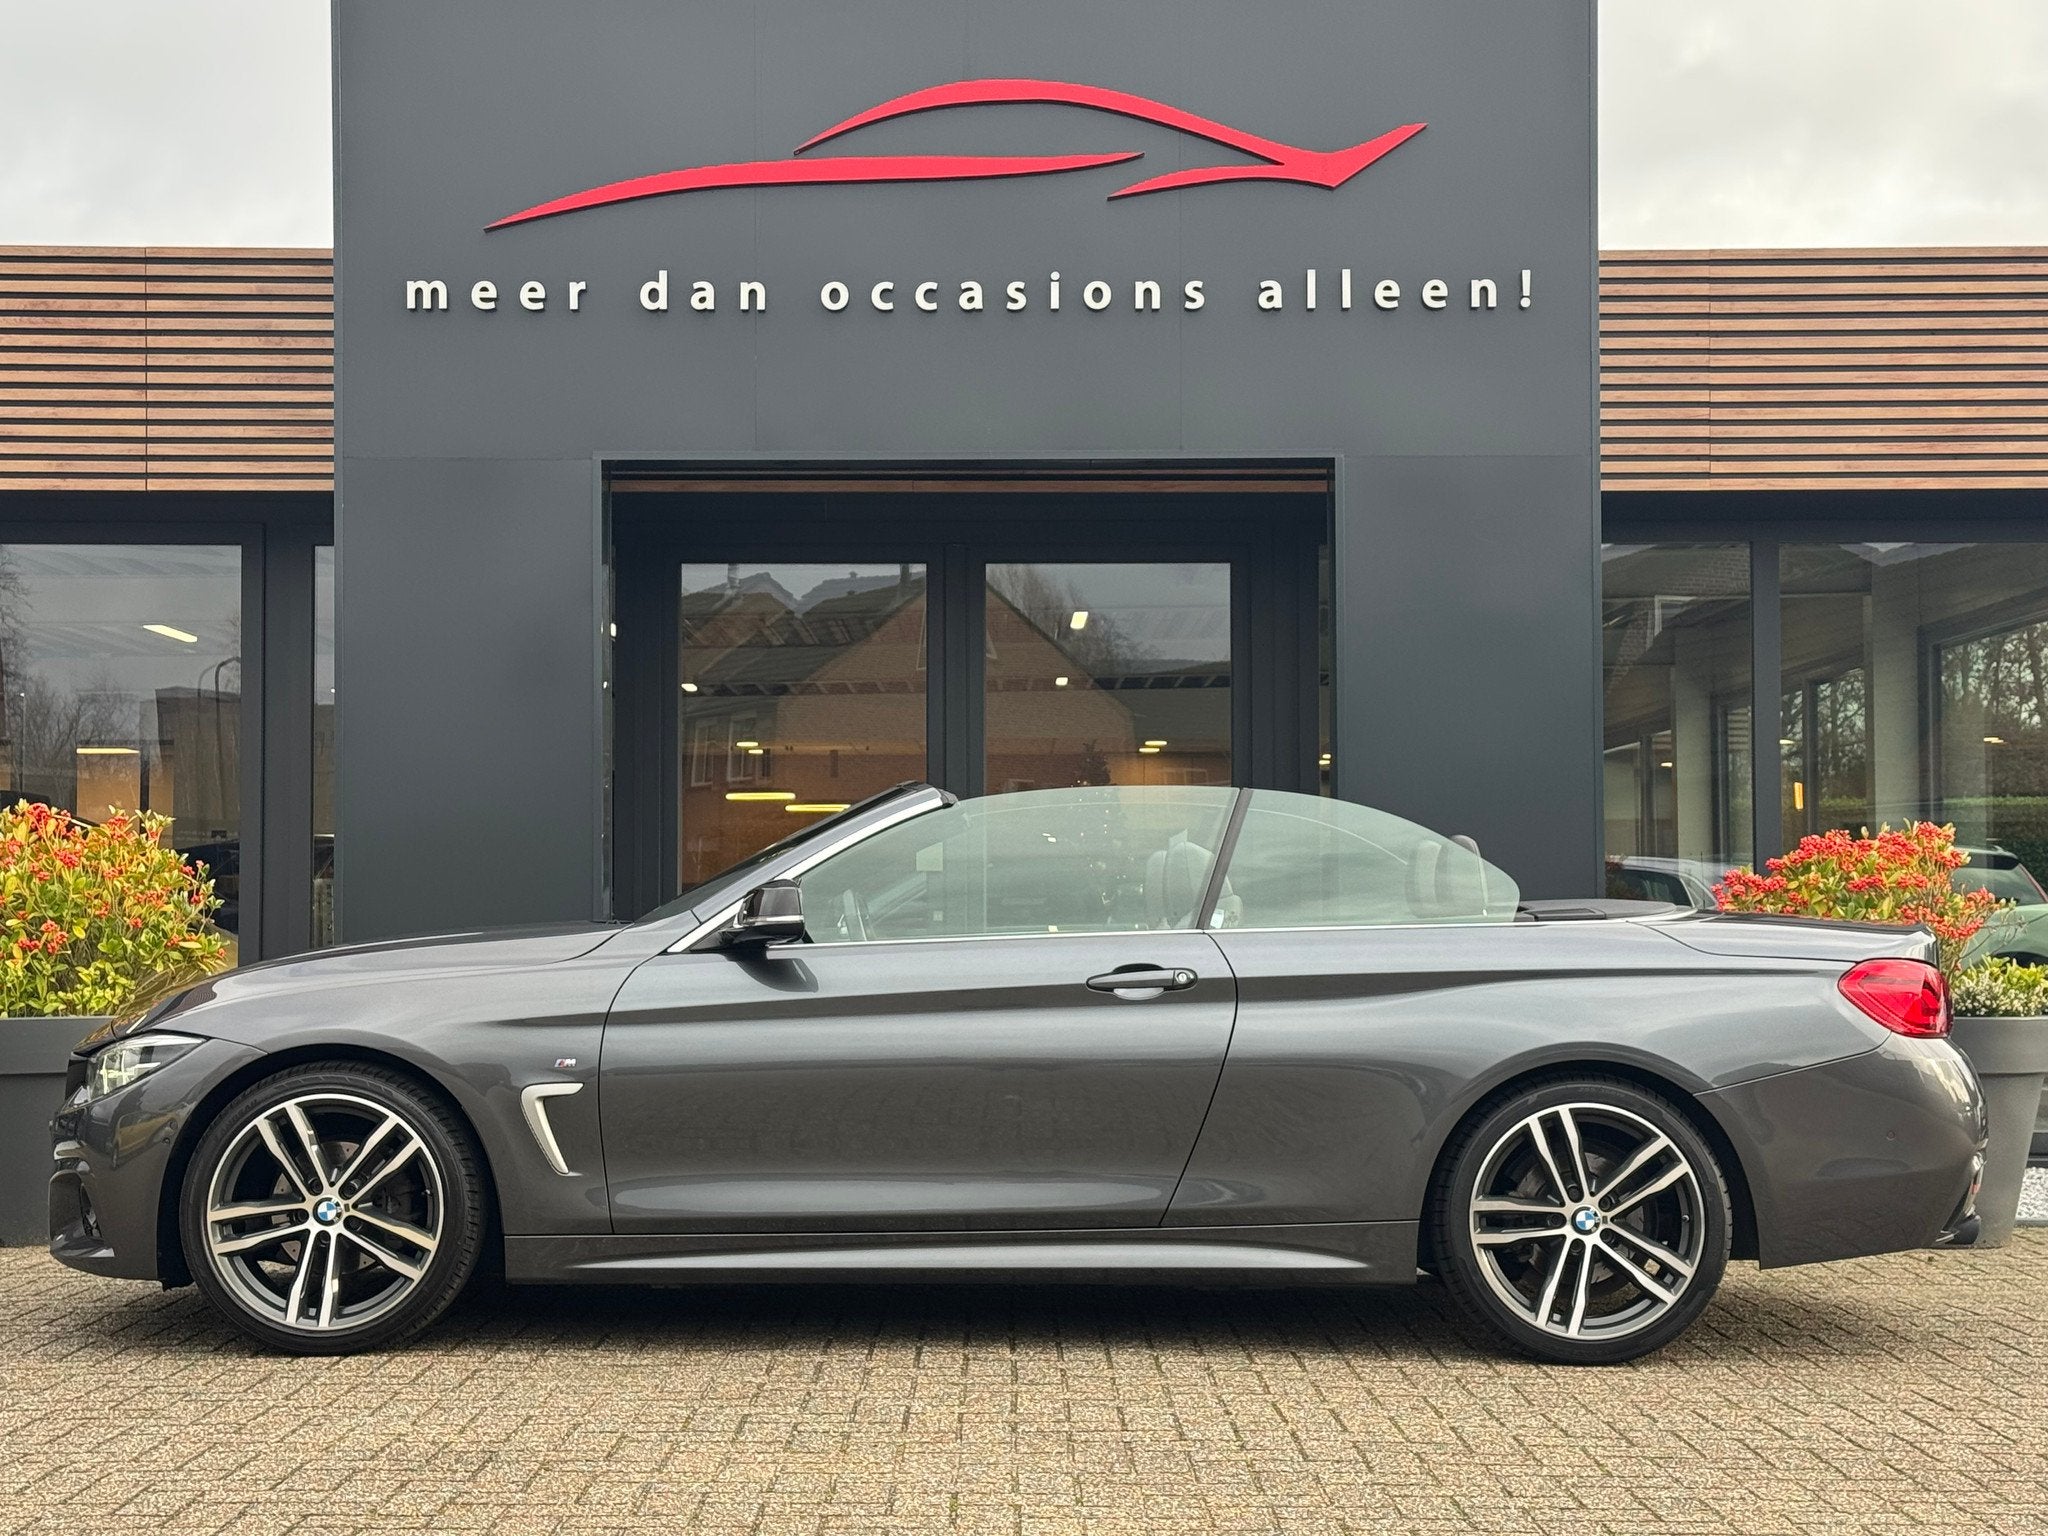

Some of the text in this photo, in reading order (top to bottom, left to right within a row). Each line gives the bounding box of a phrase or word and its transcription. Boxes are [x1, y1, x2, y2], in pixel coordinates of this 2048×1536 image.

[405, 268, 1533, 312] meer dan occasions alleen!
